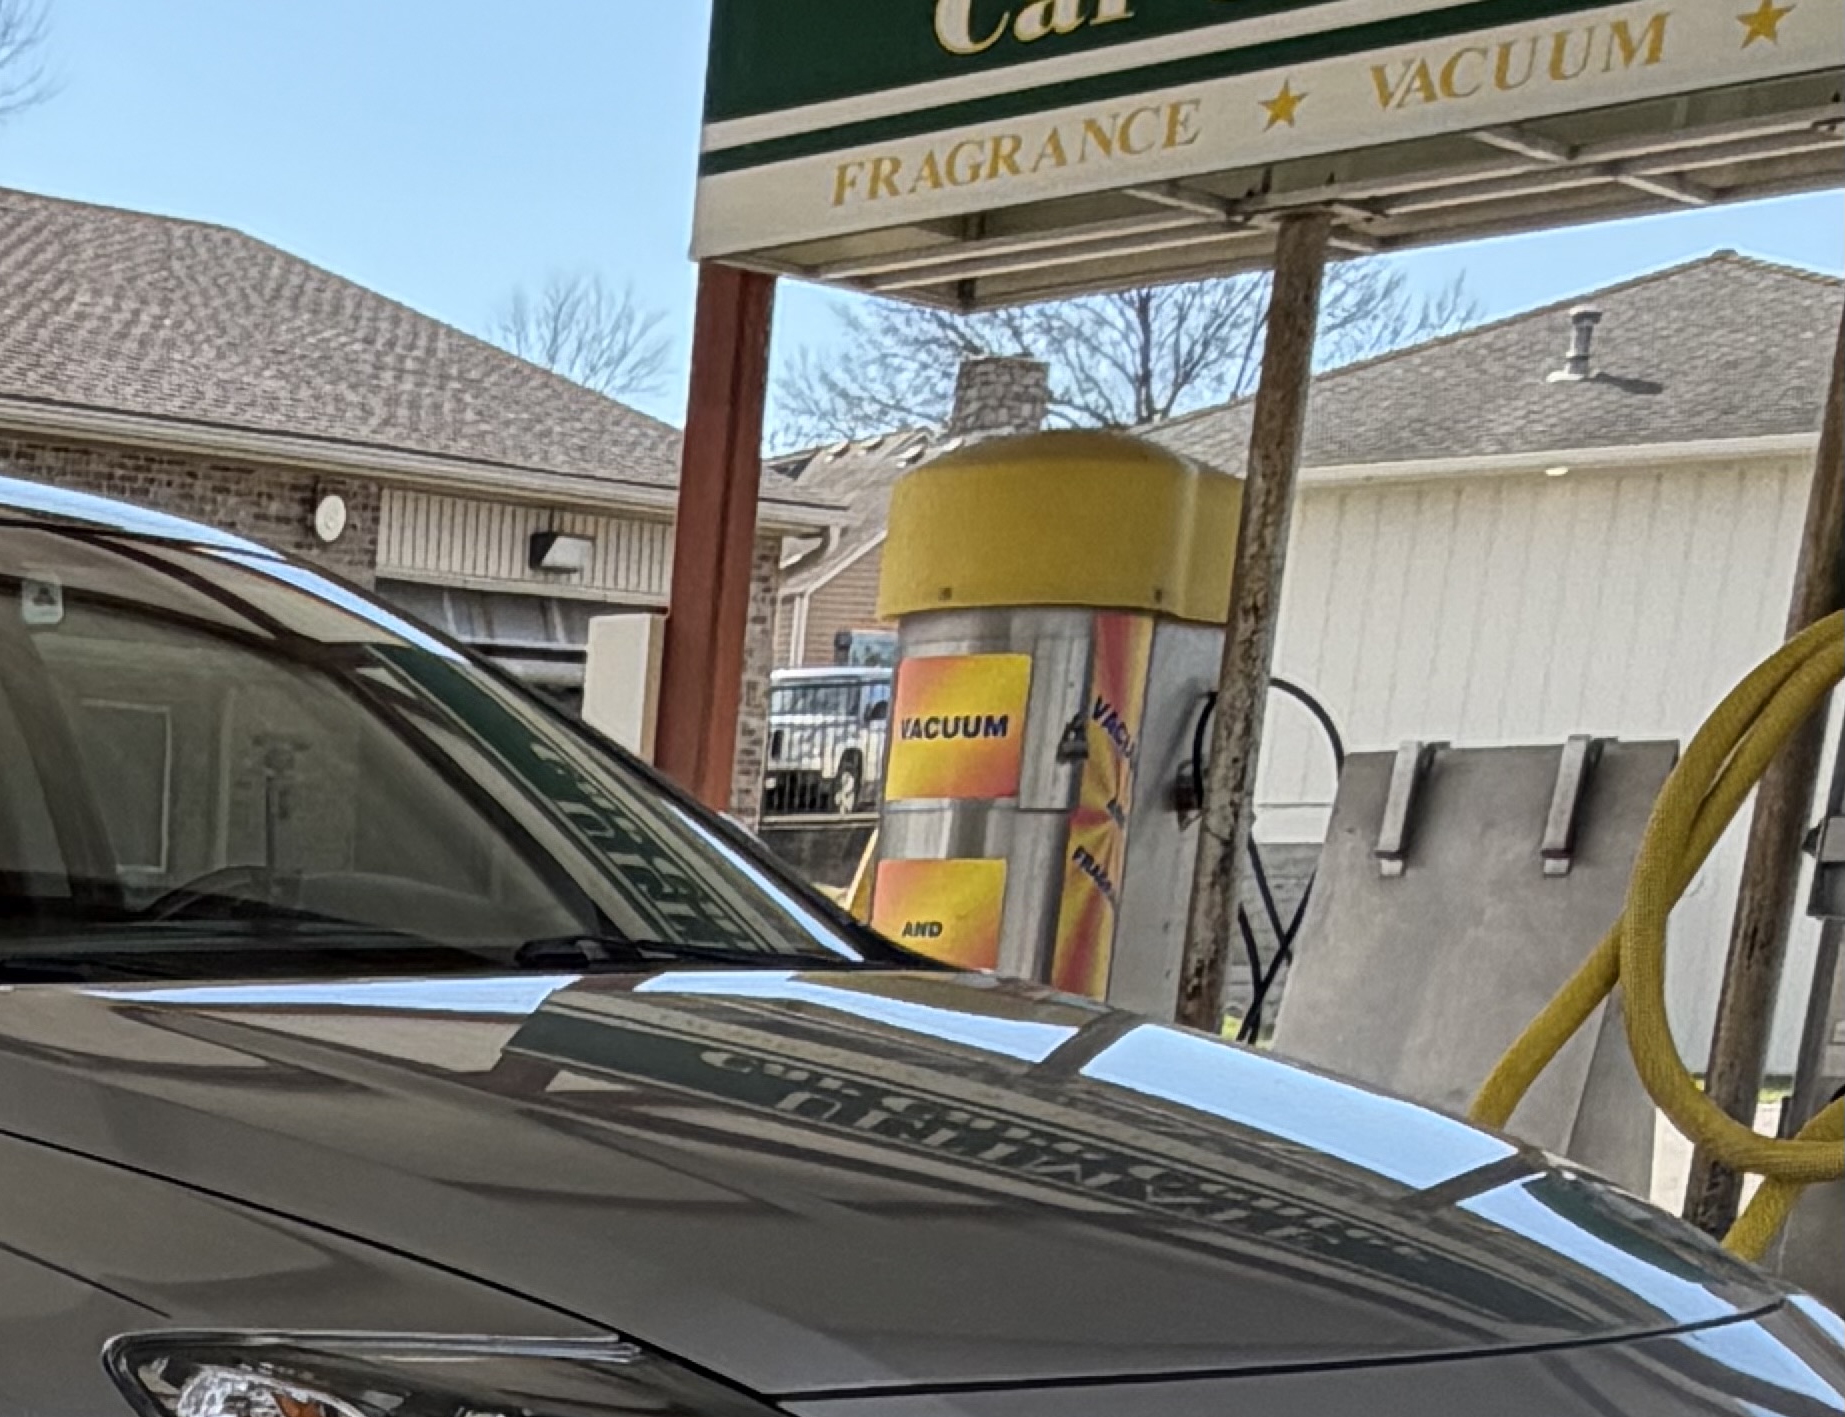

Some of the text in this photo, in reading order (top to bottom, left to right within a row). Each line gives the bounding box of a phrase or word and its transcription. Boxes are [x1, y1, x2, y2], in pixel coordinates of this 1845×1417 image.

[831, 10, 1673, 208] FRAGRANCE VACUUM
[900, 714, 1010, 740] VACUUM
[901, 920, 944, 938] AND
